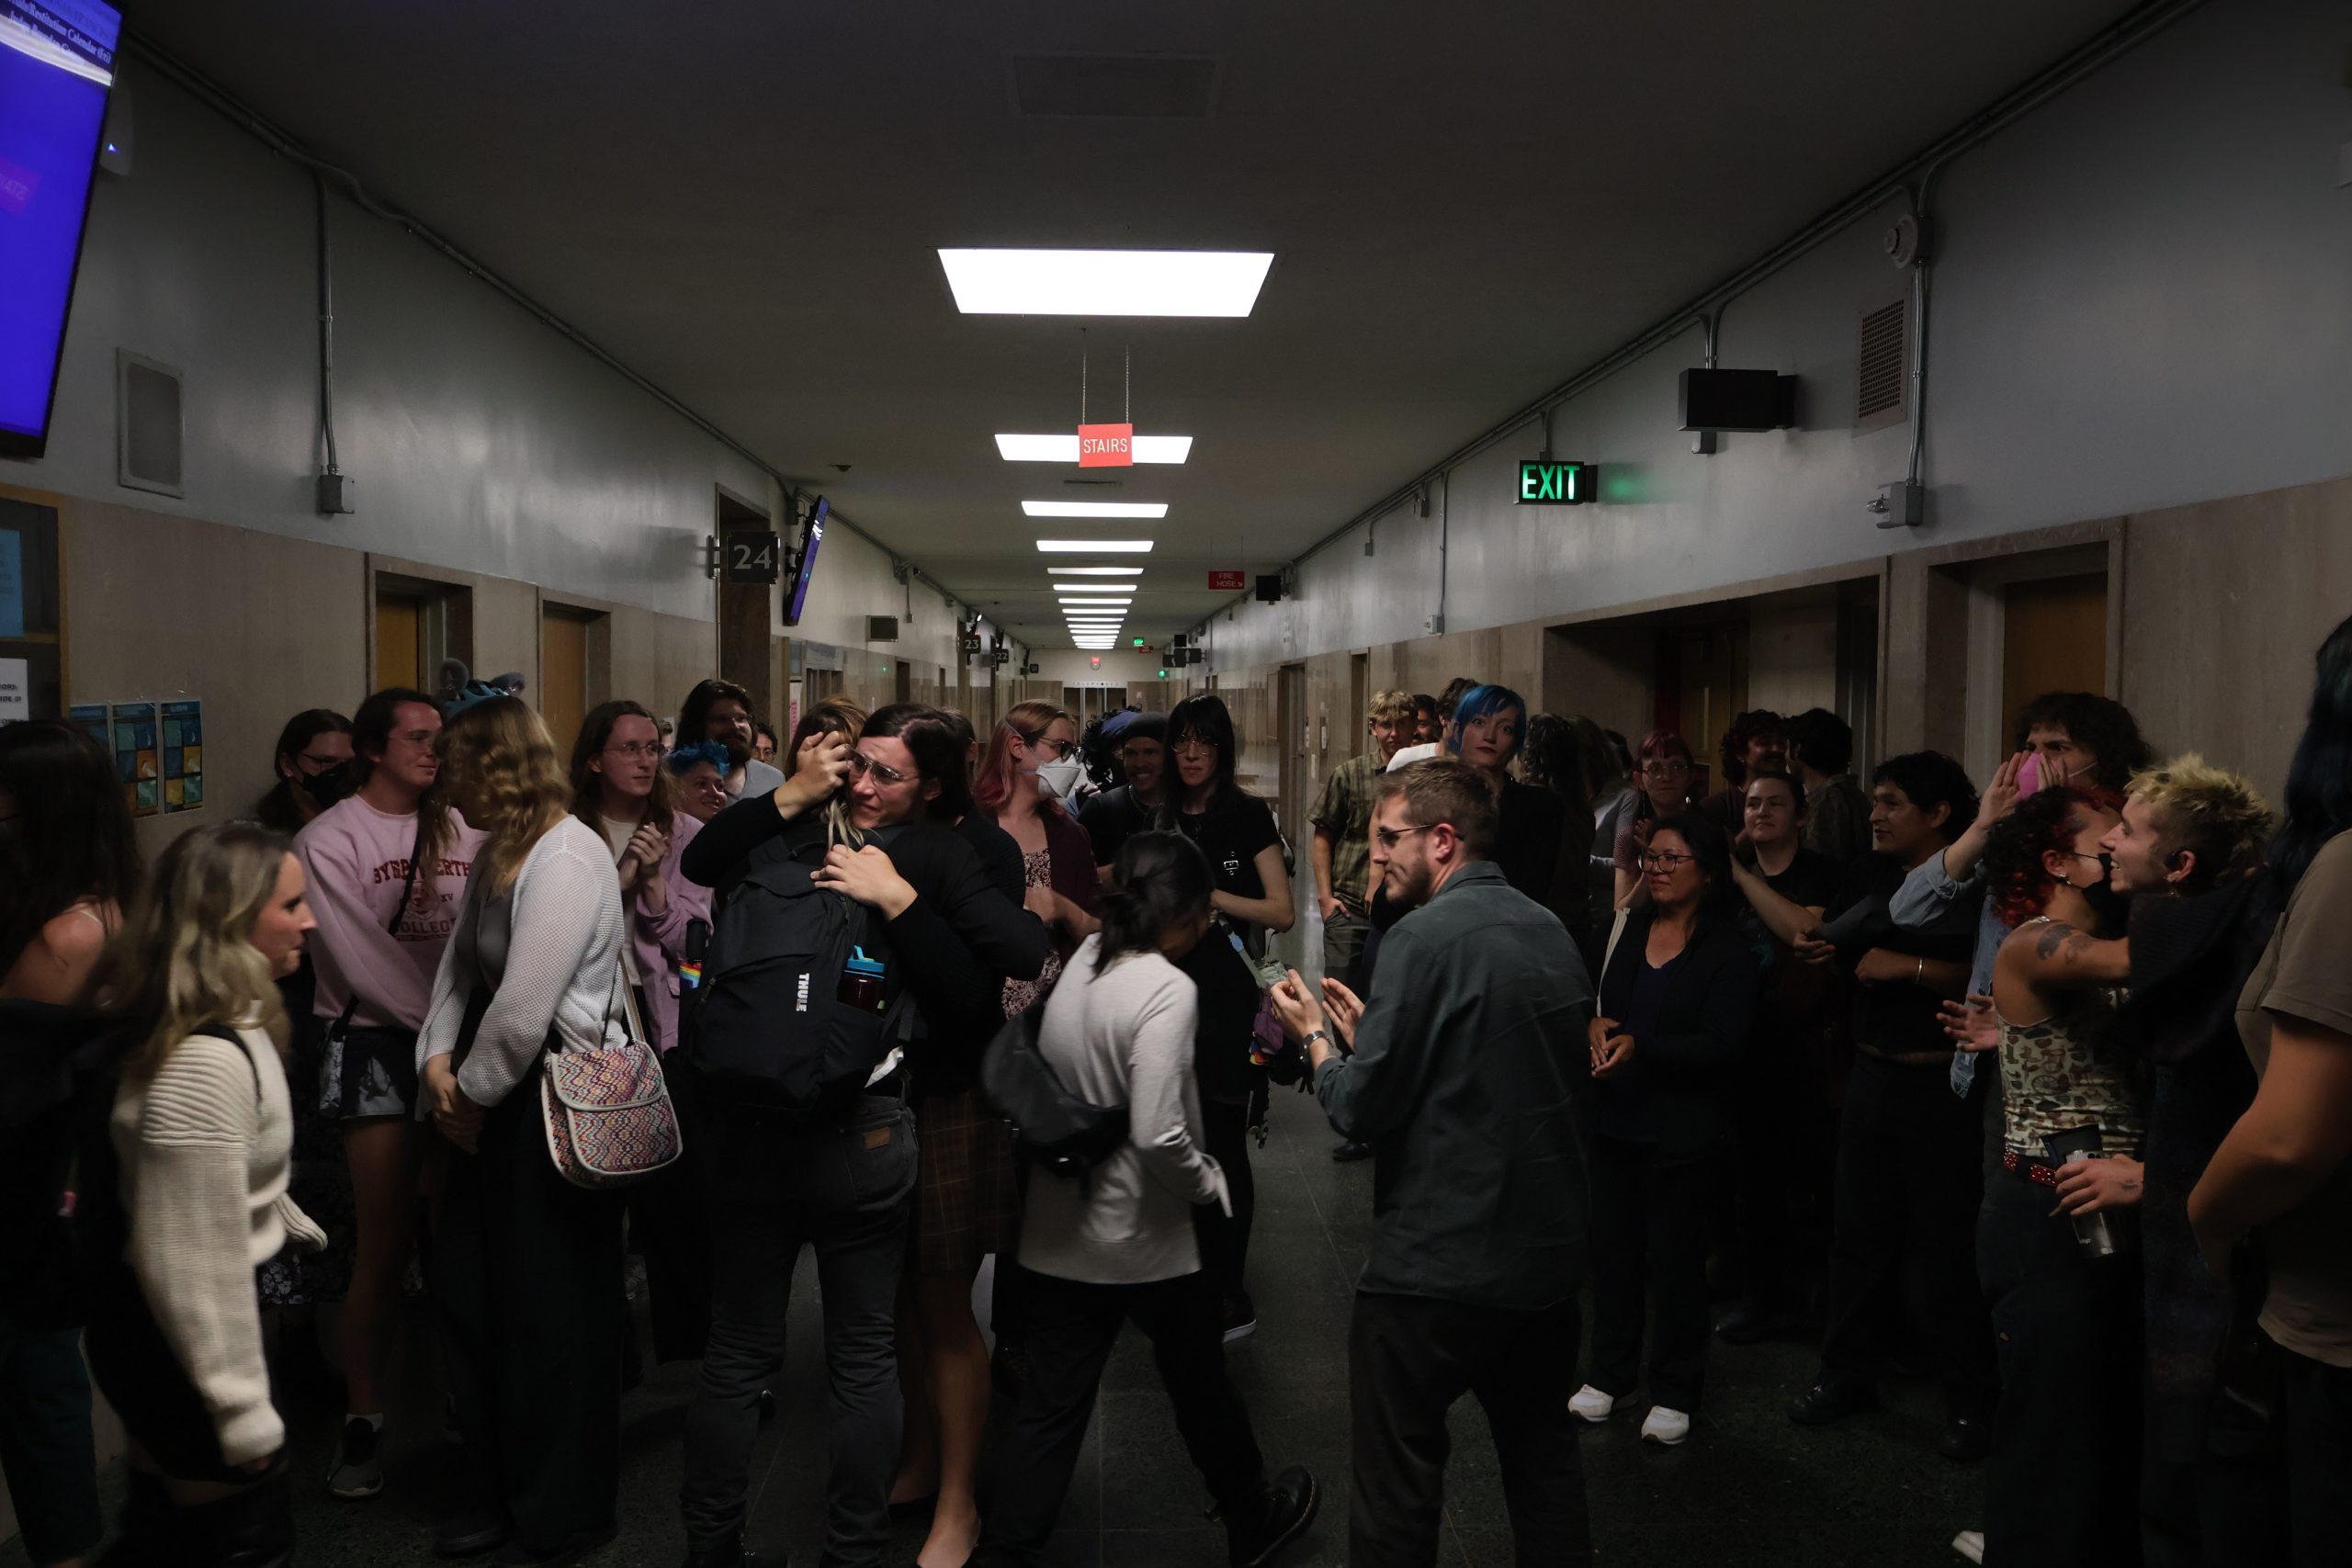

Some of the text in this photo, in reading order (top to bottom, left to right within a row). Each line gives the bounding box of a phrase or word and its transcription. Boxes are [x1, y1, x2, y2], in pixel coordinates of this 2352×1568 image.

[1083, 437, 1128, 454] STAIRS
[1521, 464, 1580, 500] EXIT
[733, 544, 772, 570] 24
[965, 639, 979, 649] 23
[997, 652, 1008, 660] 22
[399, 918, 457, 934] OLLEG
[796, 973, 809, 1011] THULE
